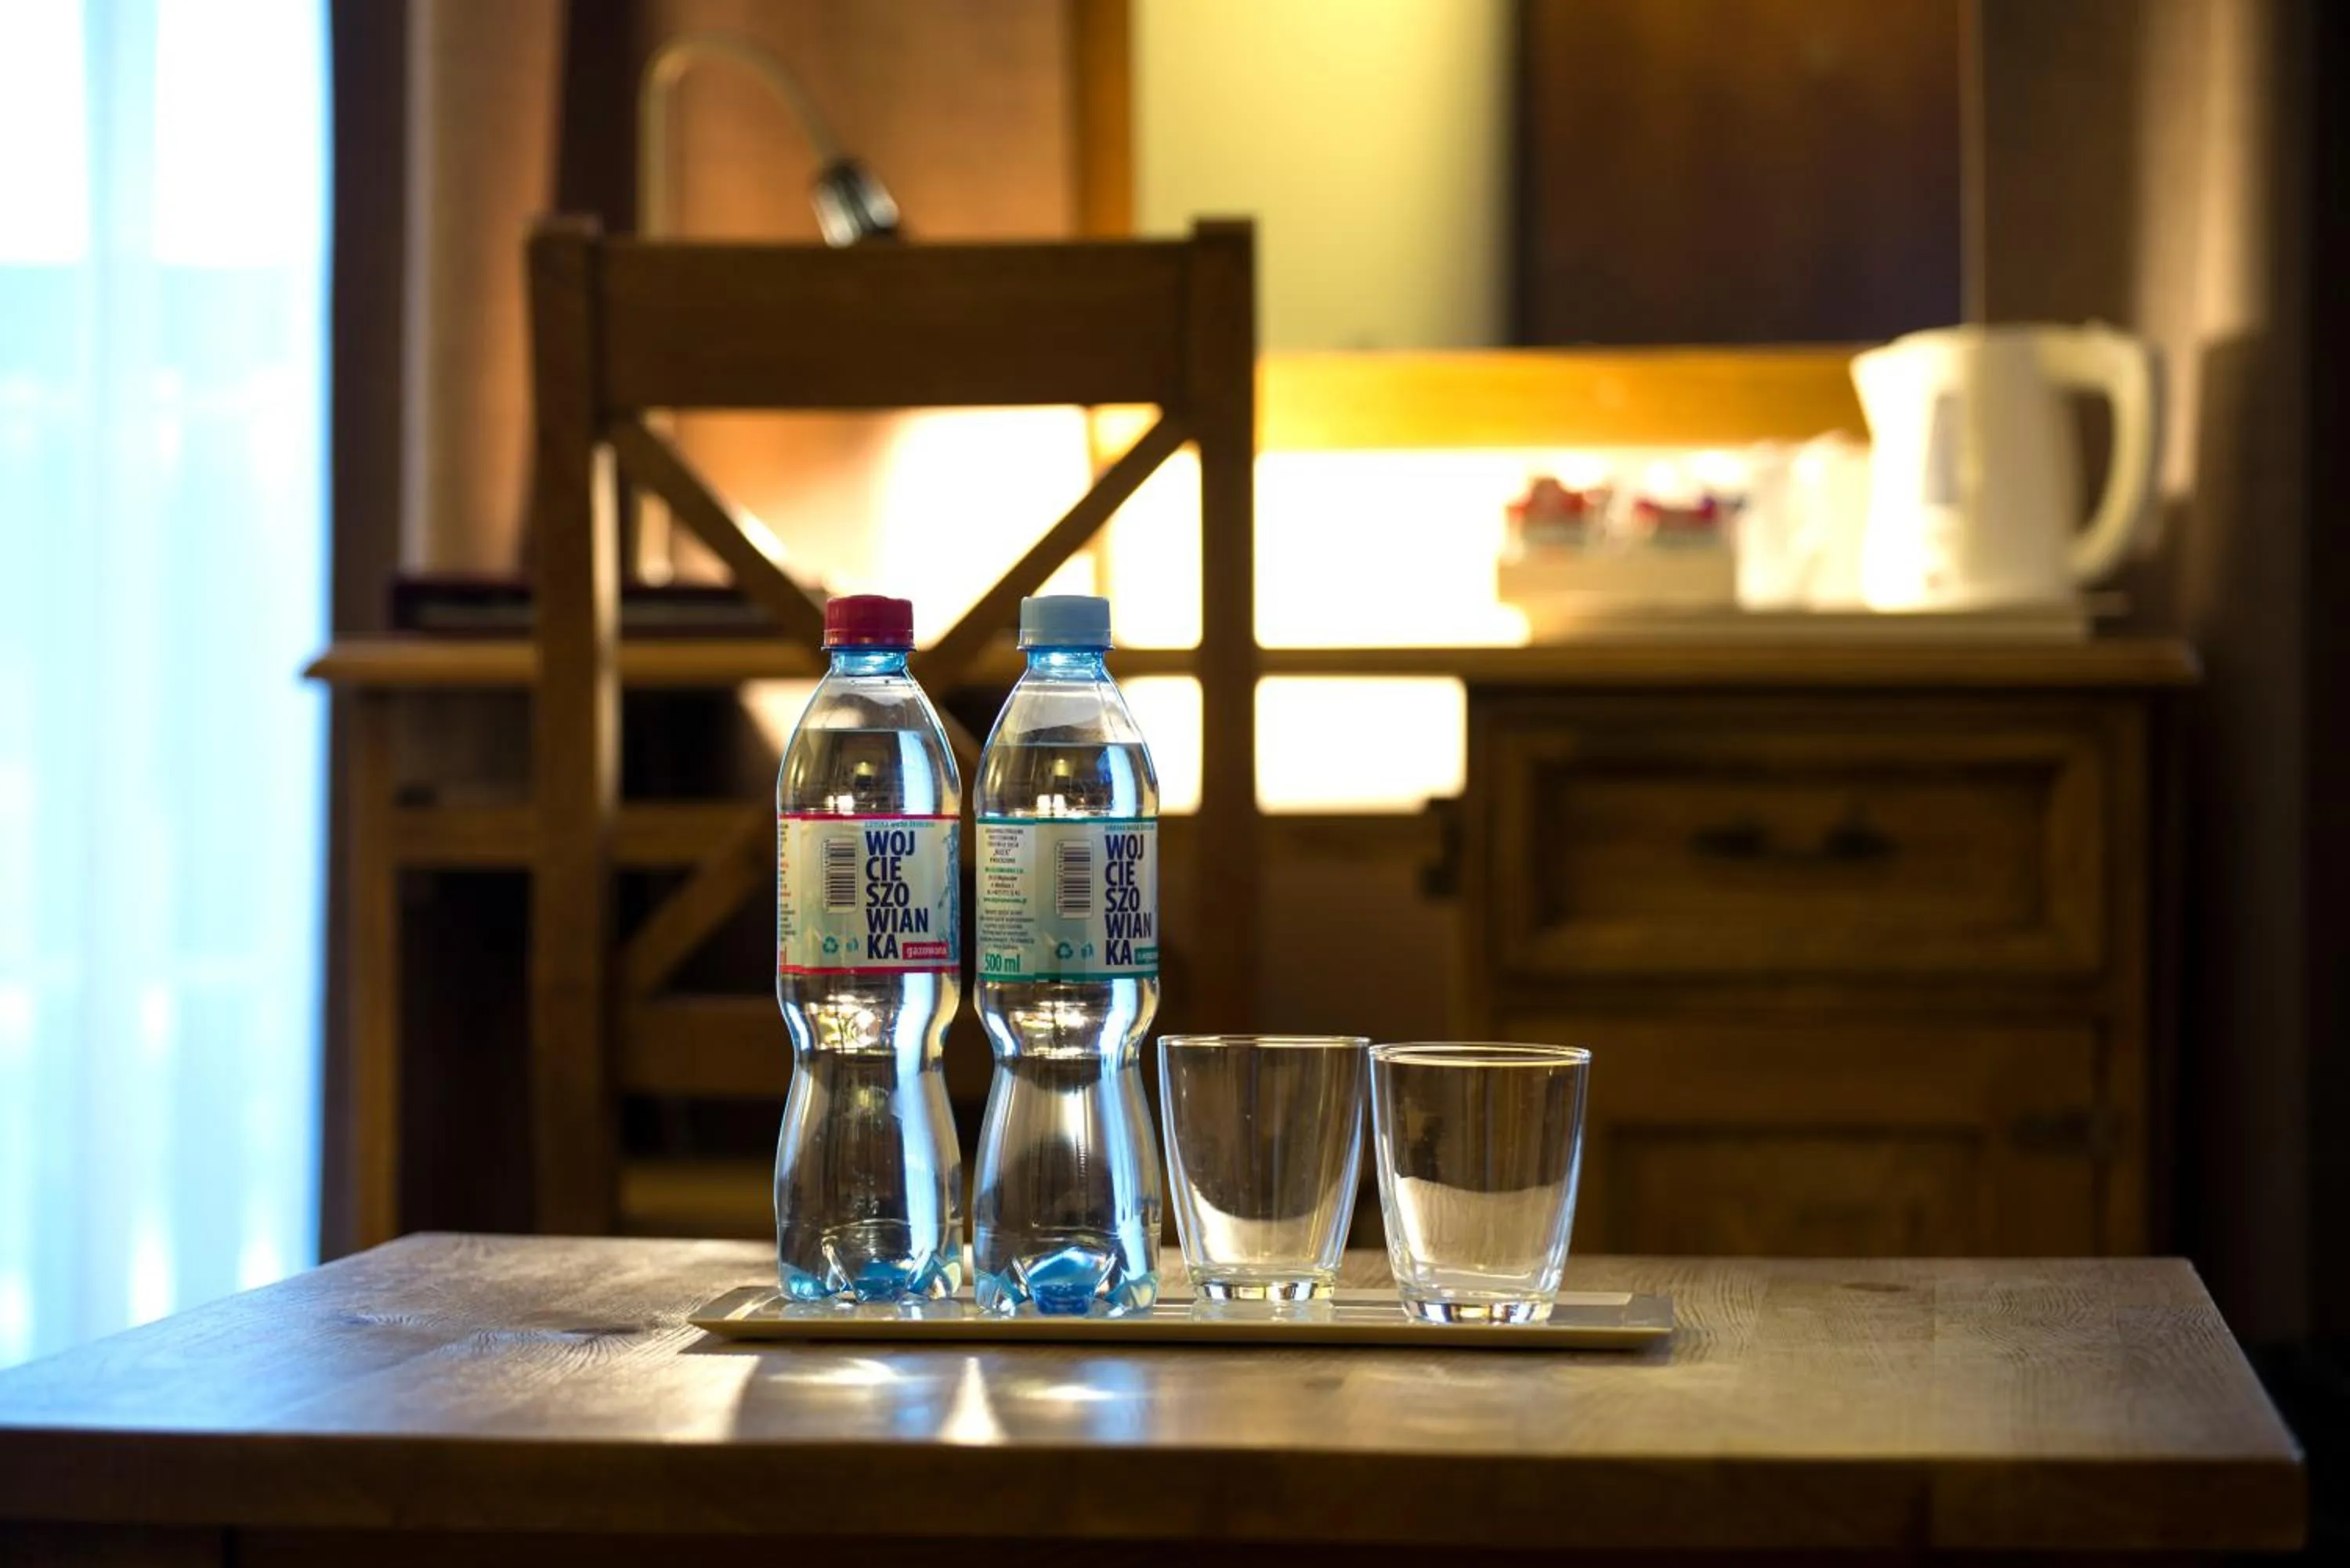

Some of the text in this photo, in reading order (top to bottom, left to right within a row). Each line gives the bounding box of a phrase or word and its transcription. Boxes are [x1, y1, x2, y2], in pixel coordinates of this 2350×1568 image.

[865, 830, 915, 855] WOJ
[1104, 834, 1144, 860] WOJ
[866, 857, 902, 881] CIE
[1105, 861, 1135, 886] CIE
[866, 883, 909, 908] SZO
[1105, 887, 1140, 912] SZO
[866, 909, 928, 933] WIAN
[1105, 912, 1152, 938] WIAN
[867, 934, 898, 959] KA
[1106, 940, 1132, 965] KA
[984, 952, 1020, 972] 500 ml
